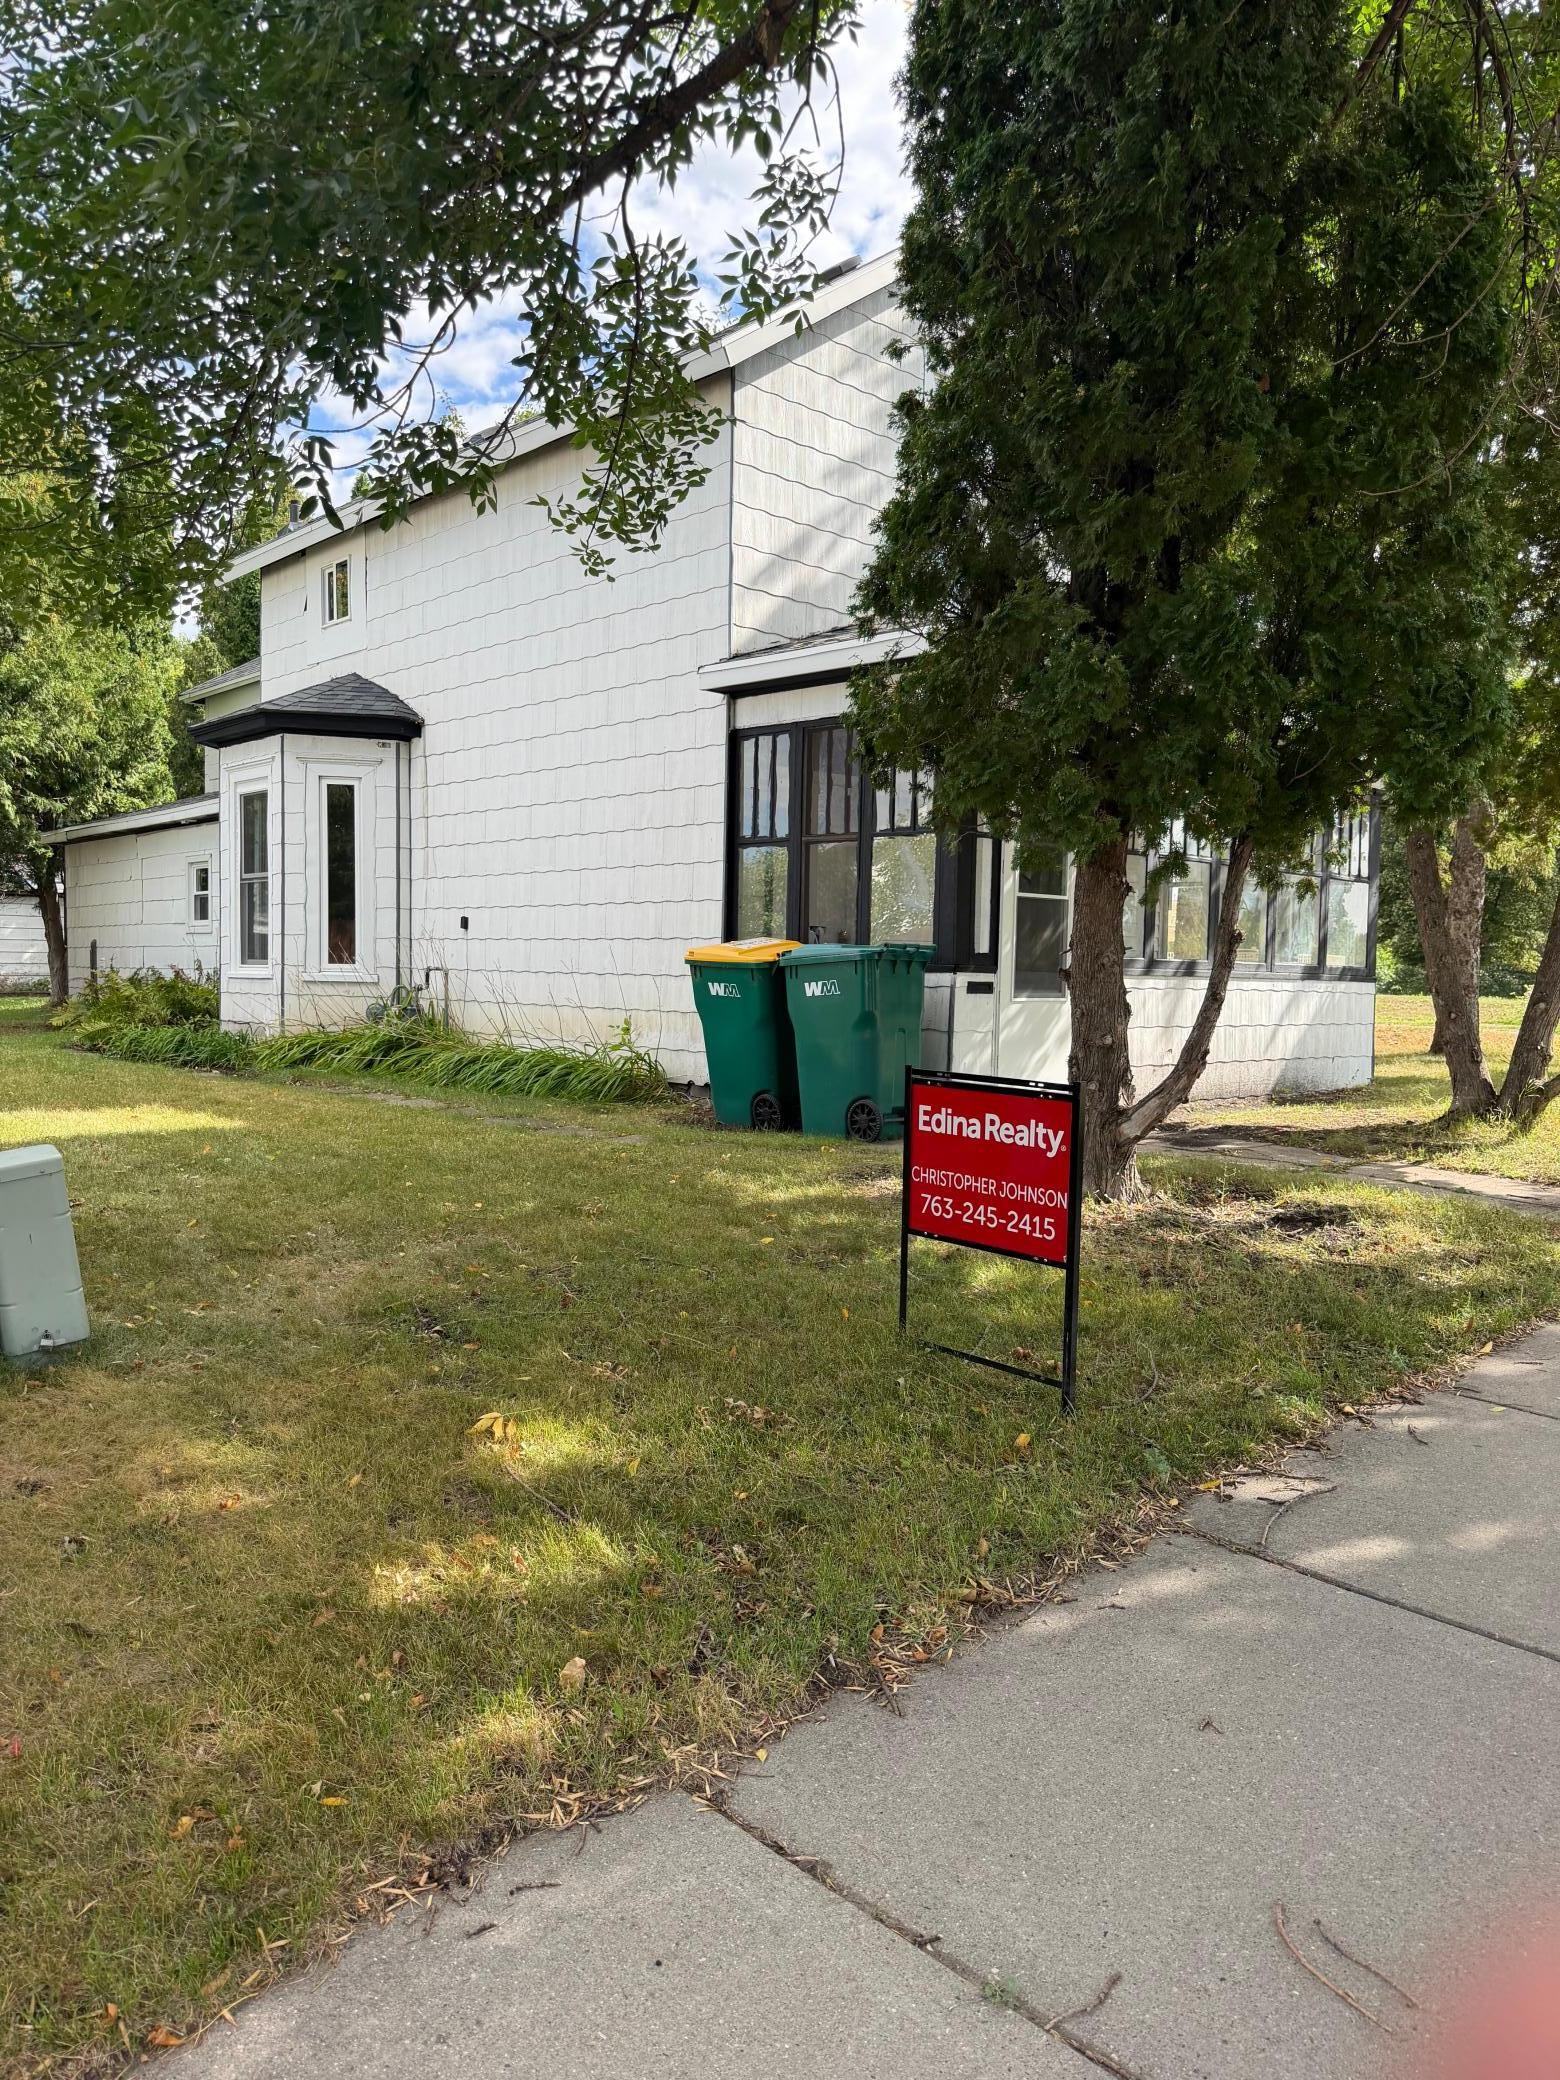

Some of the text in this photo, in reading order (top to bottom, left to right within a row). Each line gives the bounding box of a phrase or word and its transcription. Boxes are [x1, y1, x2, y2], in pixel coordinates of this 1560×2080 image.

[708, 982, 741, 998] WM
[804, 979, 841, 997] WM
[918, 1104, 1065, 1158] Edina Realty
[911, 1165, 1068, 1210] CHRISTOPHER JOHNSON
[920, 1193, 1056, 1241] 763-245-2415
